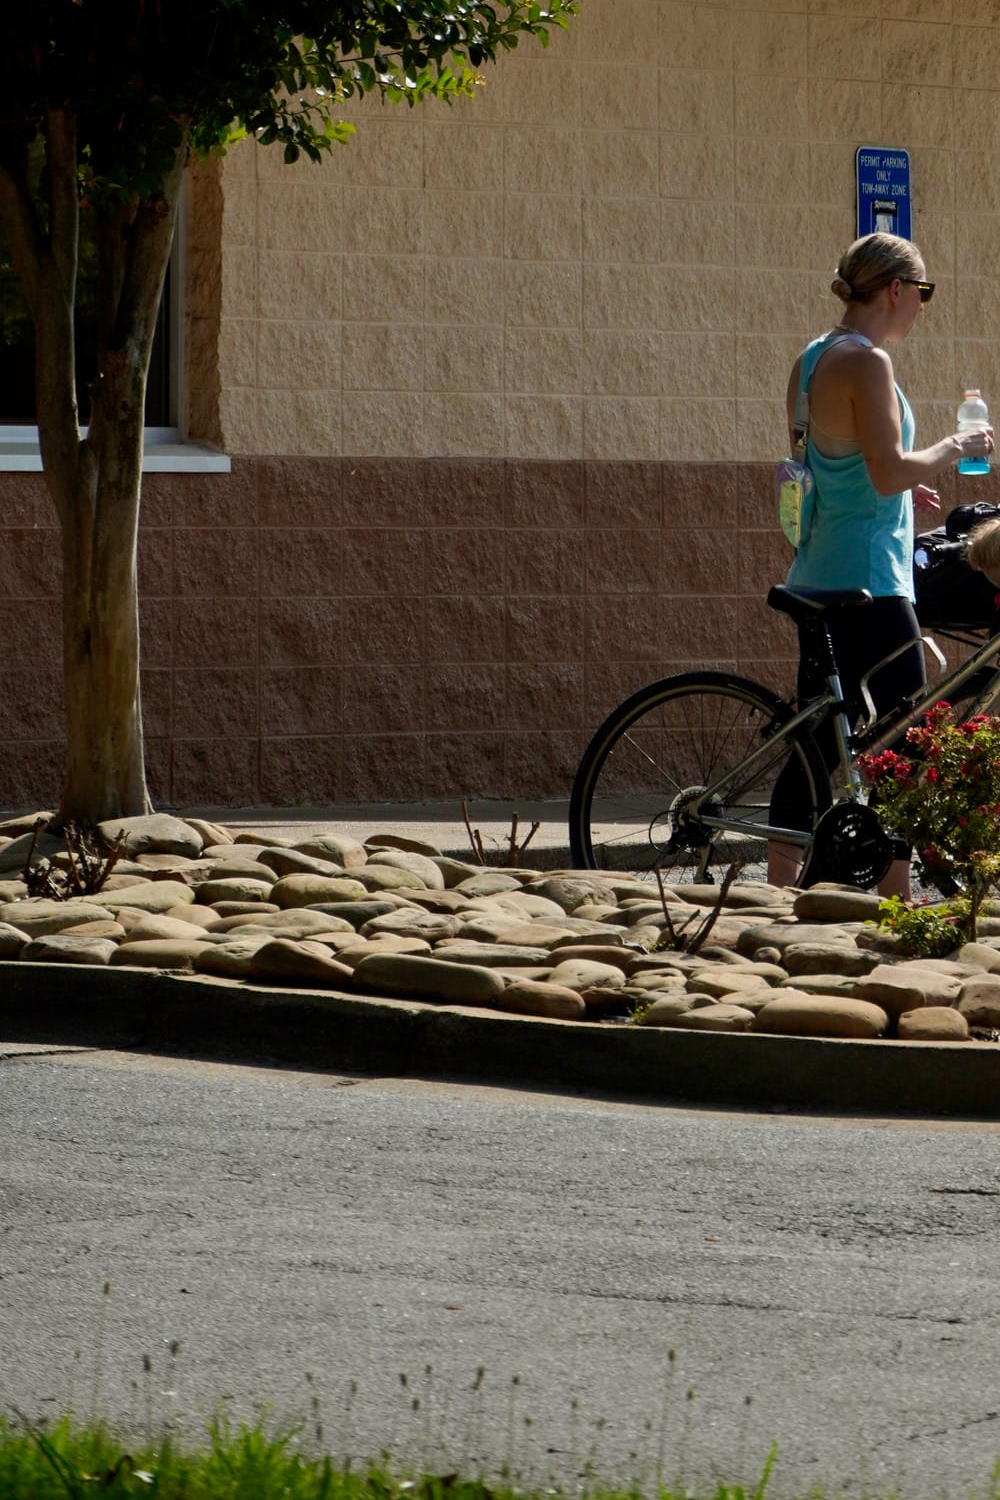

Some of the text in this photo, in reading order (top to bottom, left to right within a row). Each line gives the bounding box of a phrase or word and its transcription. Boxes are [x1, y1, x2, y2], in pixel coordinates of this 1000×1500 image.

[860, 155, 906, 169] PERMIT PARKING
[876, 170, 891, 181] ONLY
[862, 182, 906, 196] TOW-AWAY ZONE
